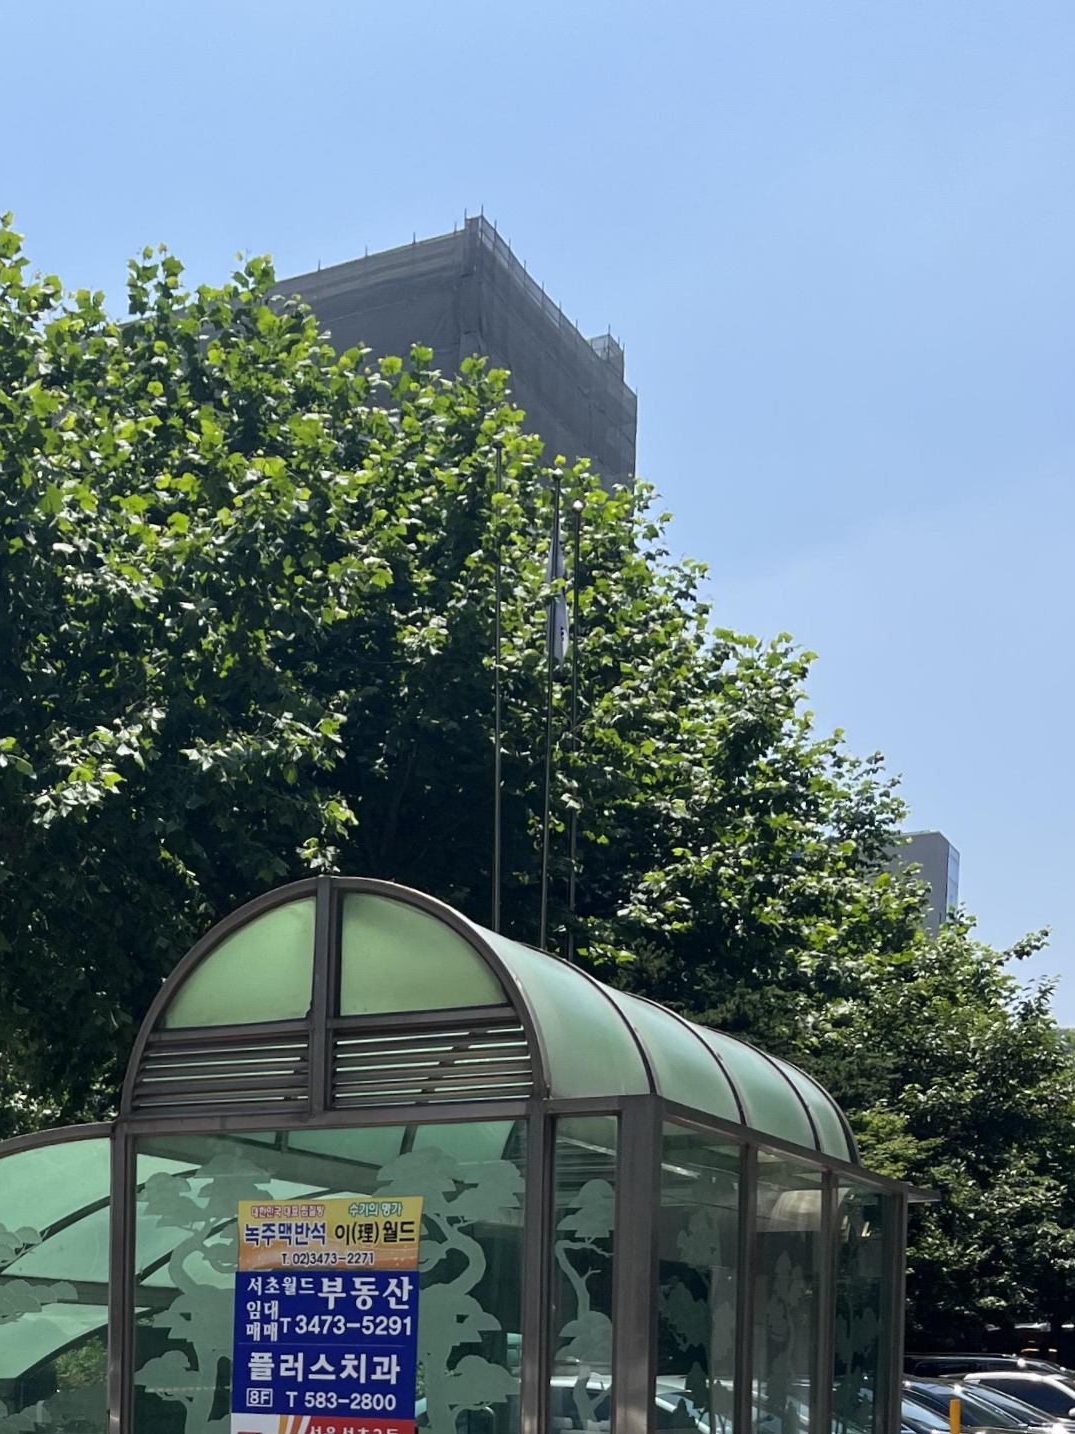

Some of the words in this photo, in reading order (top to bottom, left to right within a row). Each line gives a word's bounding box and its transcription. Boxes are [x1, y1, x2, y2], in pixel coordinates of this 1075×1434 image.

[251, 1205, 283, 1218] 대한민국
[349, 1203, 379, 1217] 수기의
[244, 1222, 326, 1246] 녹주맥반석
[293, 1252, 374, 1267] 02)3473-2271
[247, 1276, 315, 1296] 서초월드
[317, 1276, 414, 1310] 부동산
[246, 1300, 279, 1320] 임대
[245, 1321, 278, 1342] 매매
[280, 1317, 291, 1333] T
[294, 1315, 412, 1337] 3473-5291
[247, 1352, 401, 1385] 플러스치과
[249, 1390, 270, 1406] 8F
[286, 1391, 298, 1408] T
[304, 1391, 396, 1411] 583-2800
